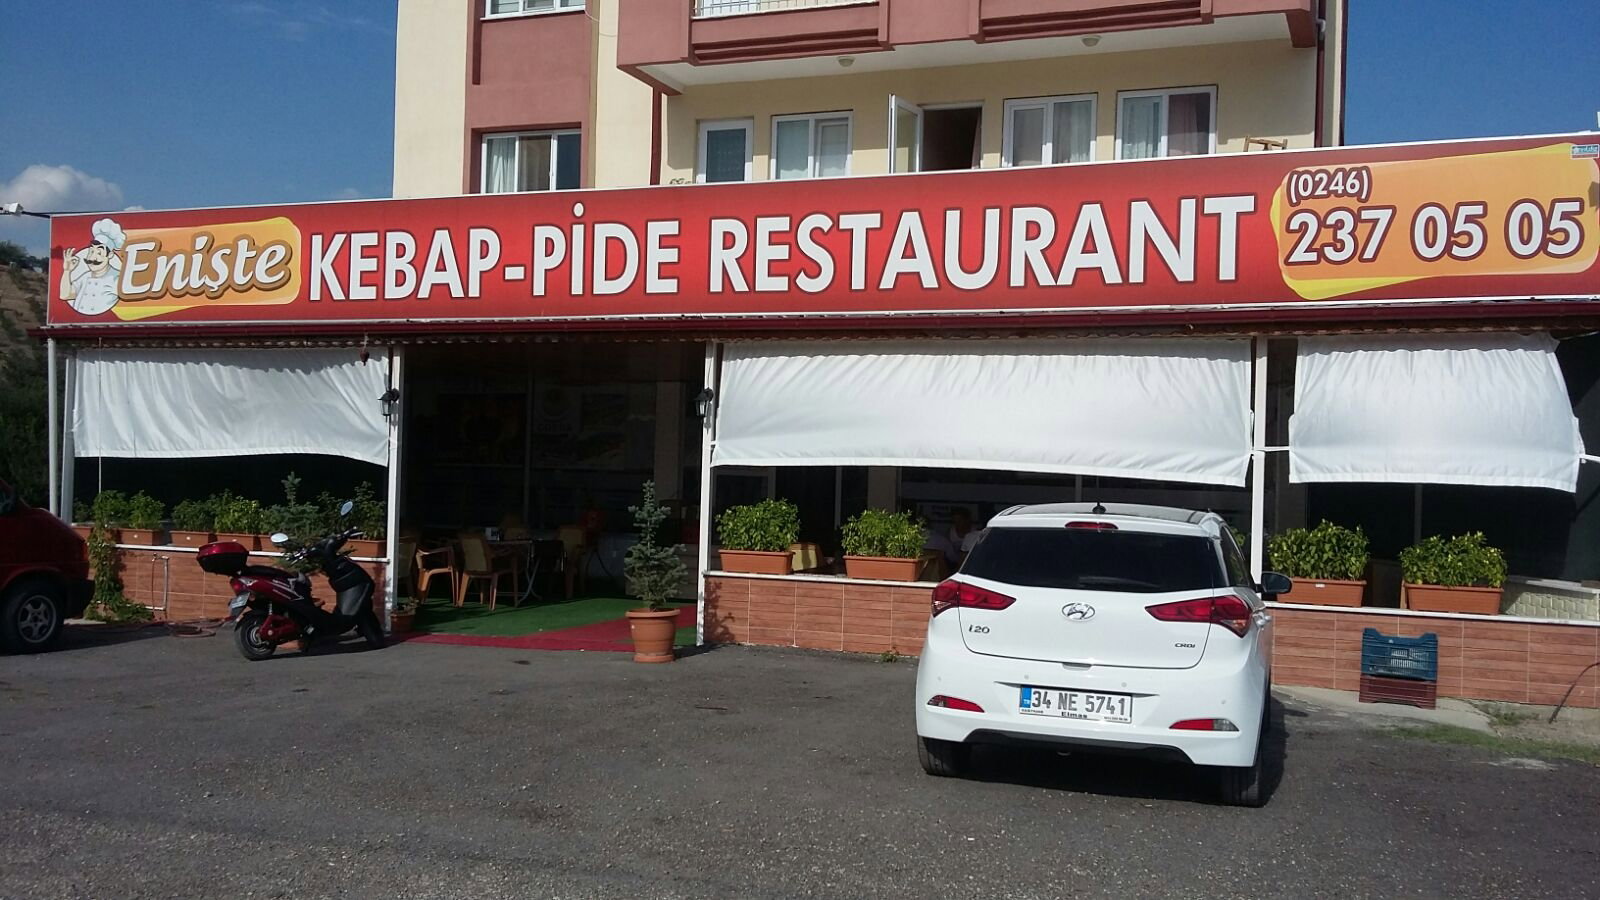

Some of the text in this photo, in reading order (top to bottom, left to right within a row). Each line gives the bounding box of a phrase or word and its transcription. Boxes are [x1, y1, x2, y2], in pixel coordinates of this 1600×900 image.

[1289, 169, 1369, 204] (0246)
[309, 195, 1255, 301] KEBAP-PİDE RESTAURANT
[1288, 201, 1585, 263] 237 05 05
[121, 235, 286, 294] Enişte
[1031, 690, 1126, 716] 34 NE 5741
